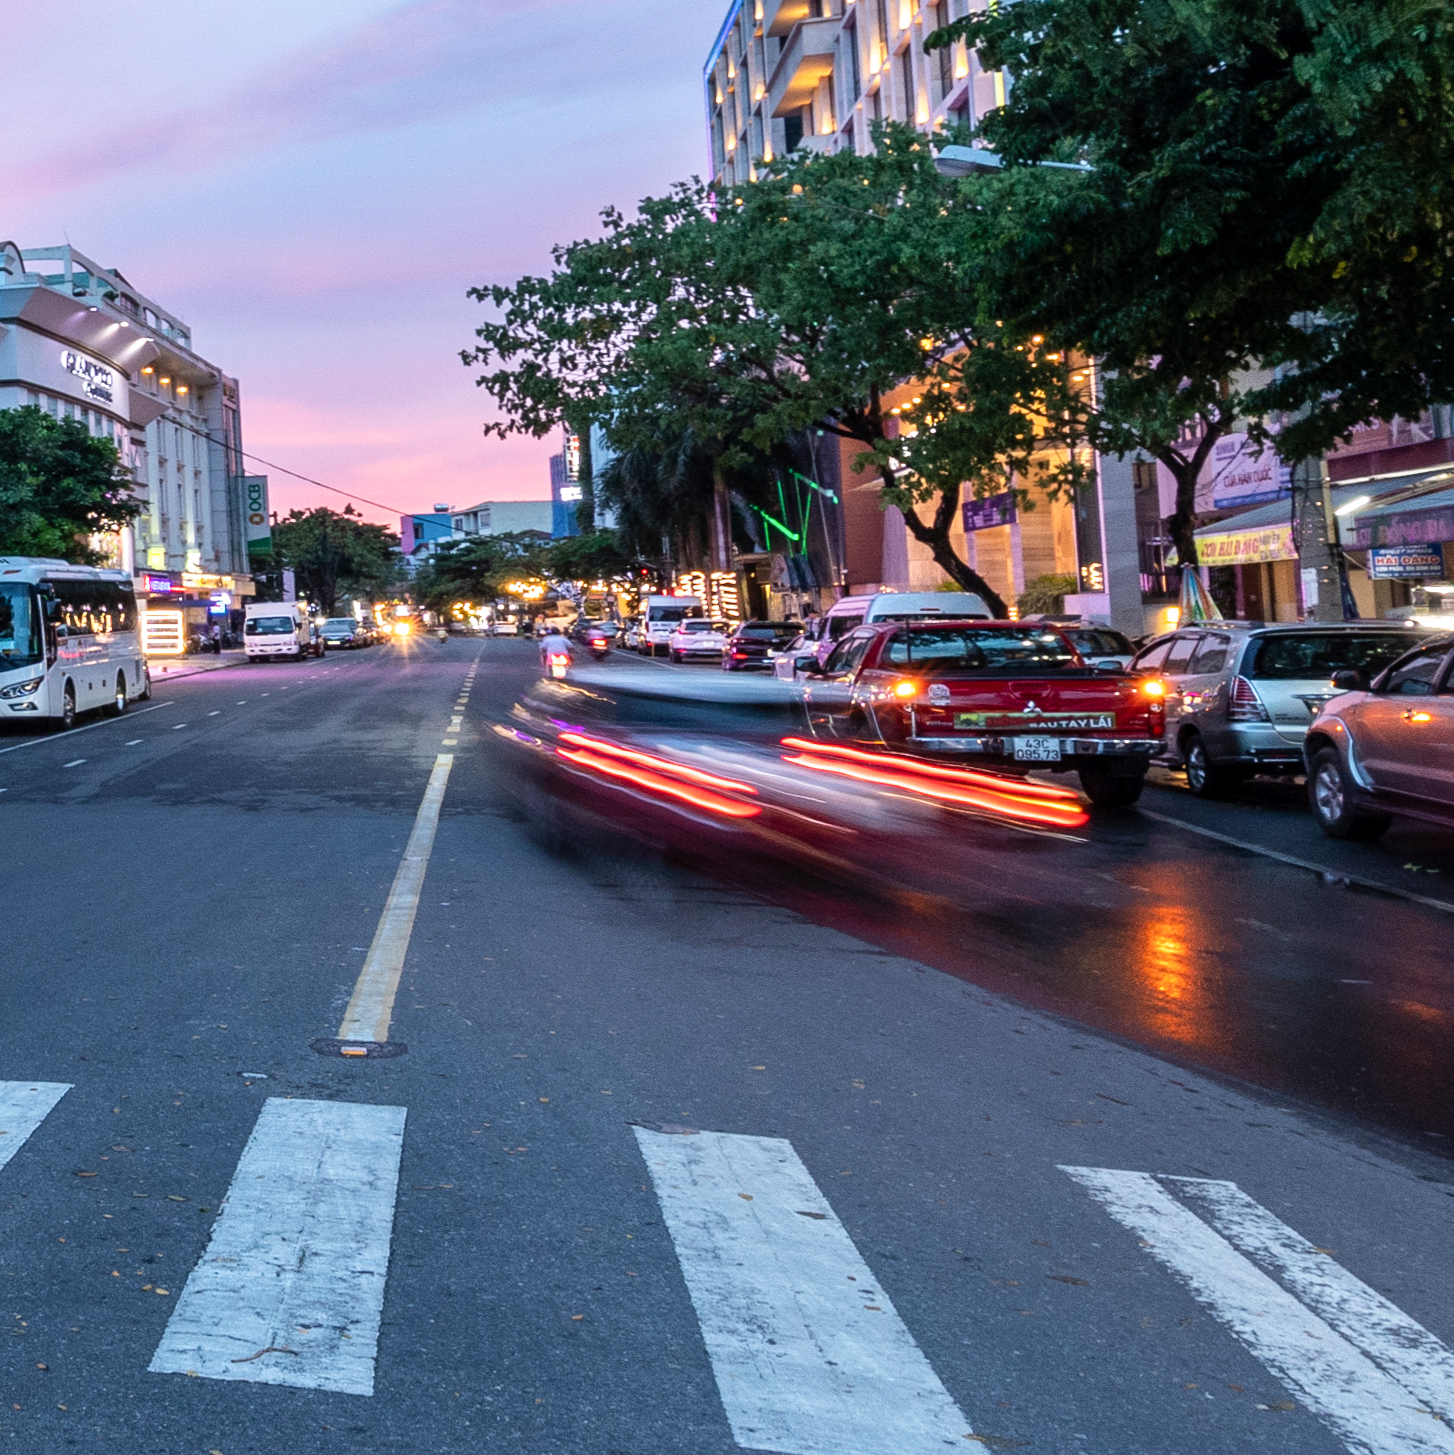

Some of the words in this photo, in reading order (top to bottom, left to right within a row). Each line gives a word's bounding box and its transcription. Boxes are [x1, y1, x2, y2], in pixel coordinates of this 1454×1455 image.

[248, 484, 261, 512] OCB
[1059, 719, 1087, 728] TAY
[1090, 715, 1112, 728] LÁI
[1026, 739, 1049, 749] 43C
[1016, 749, 1059, 759] 095.73
